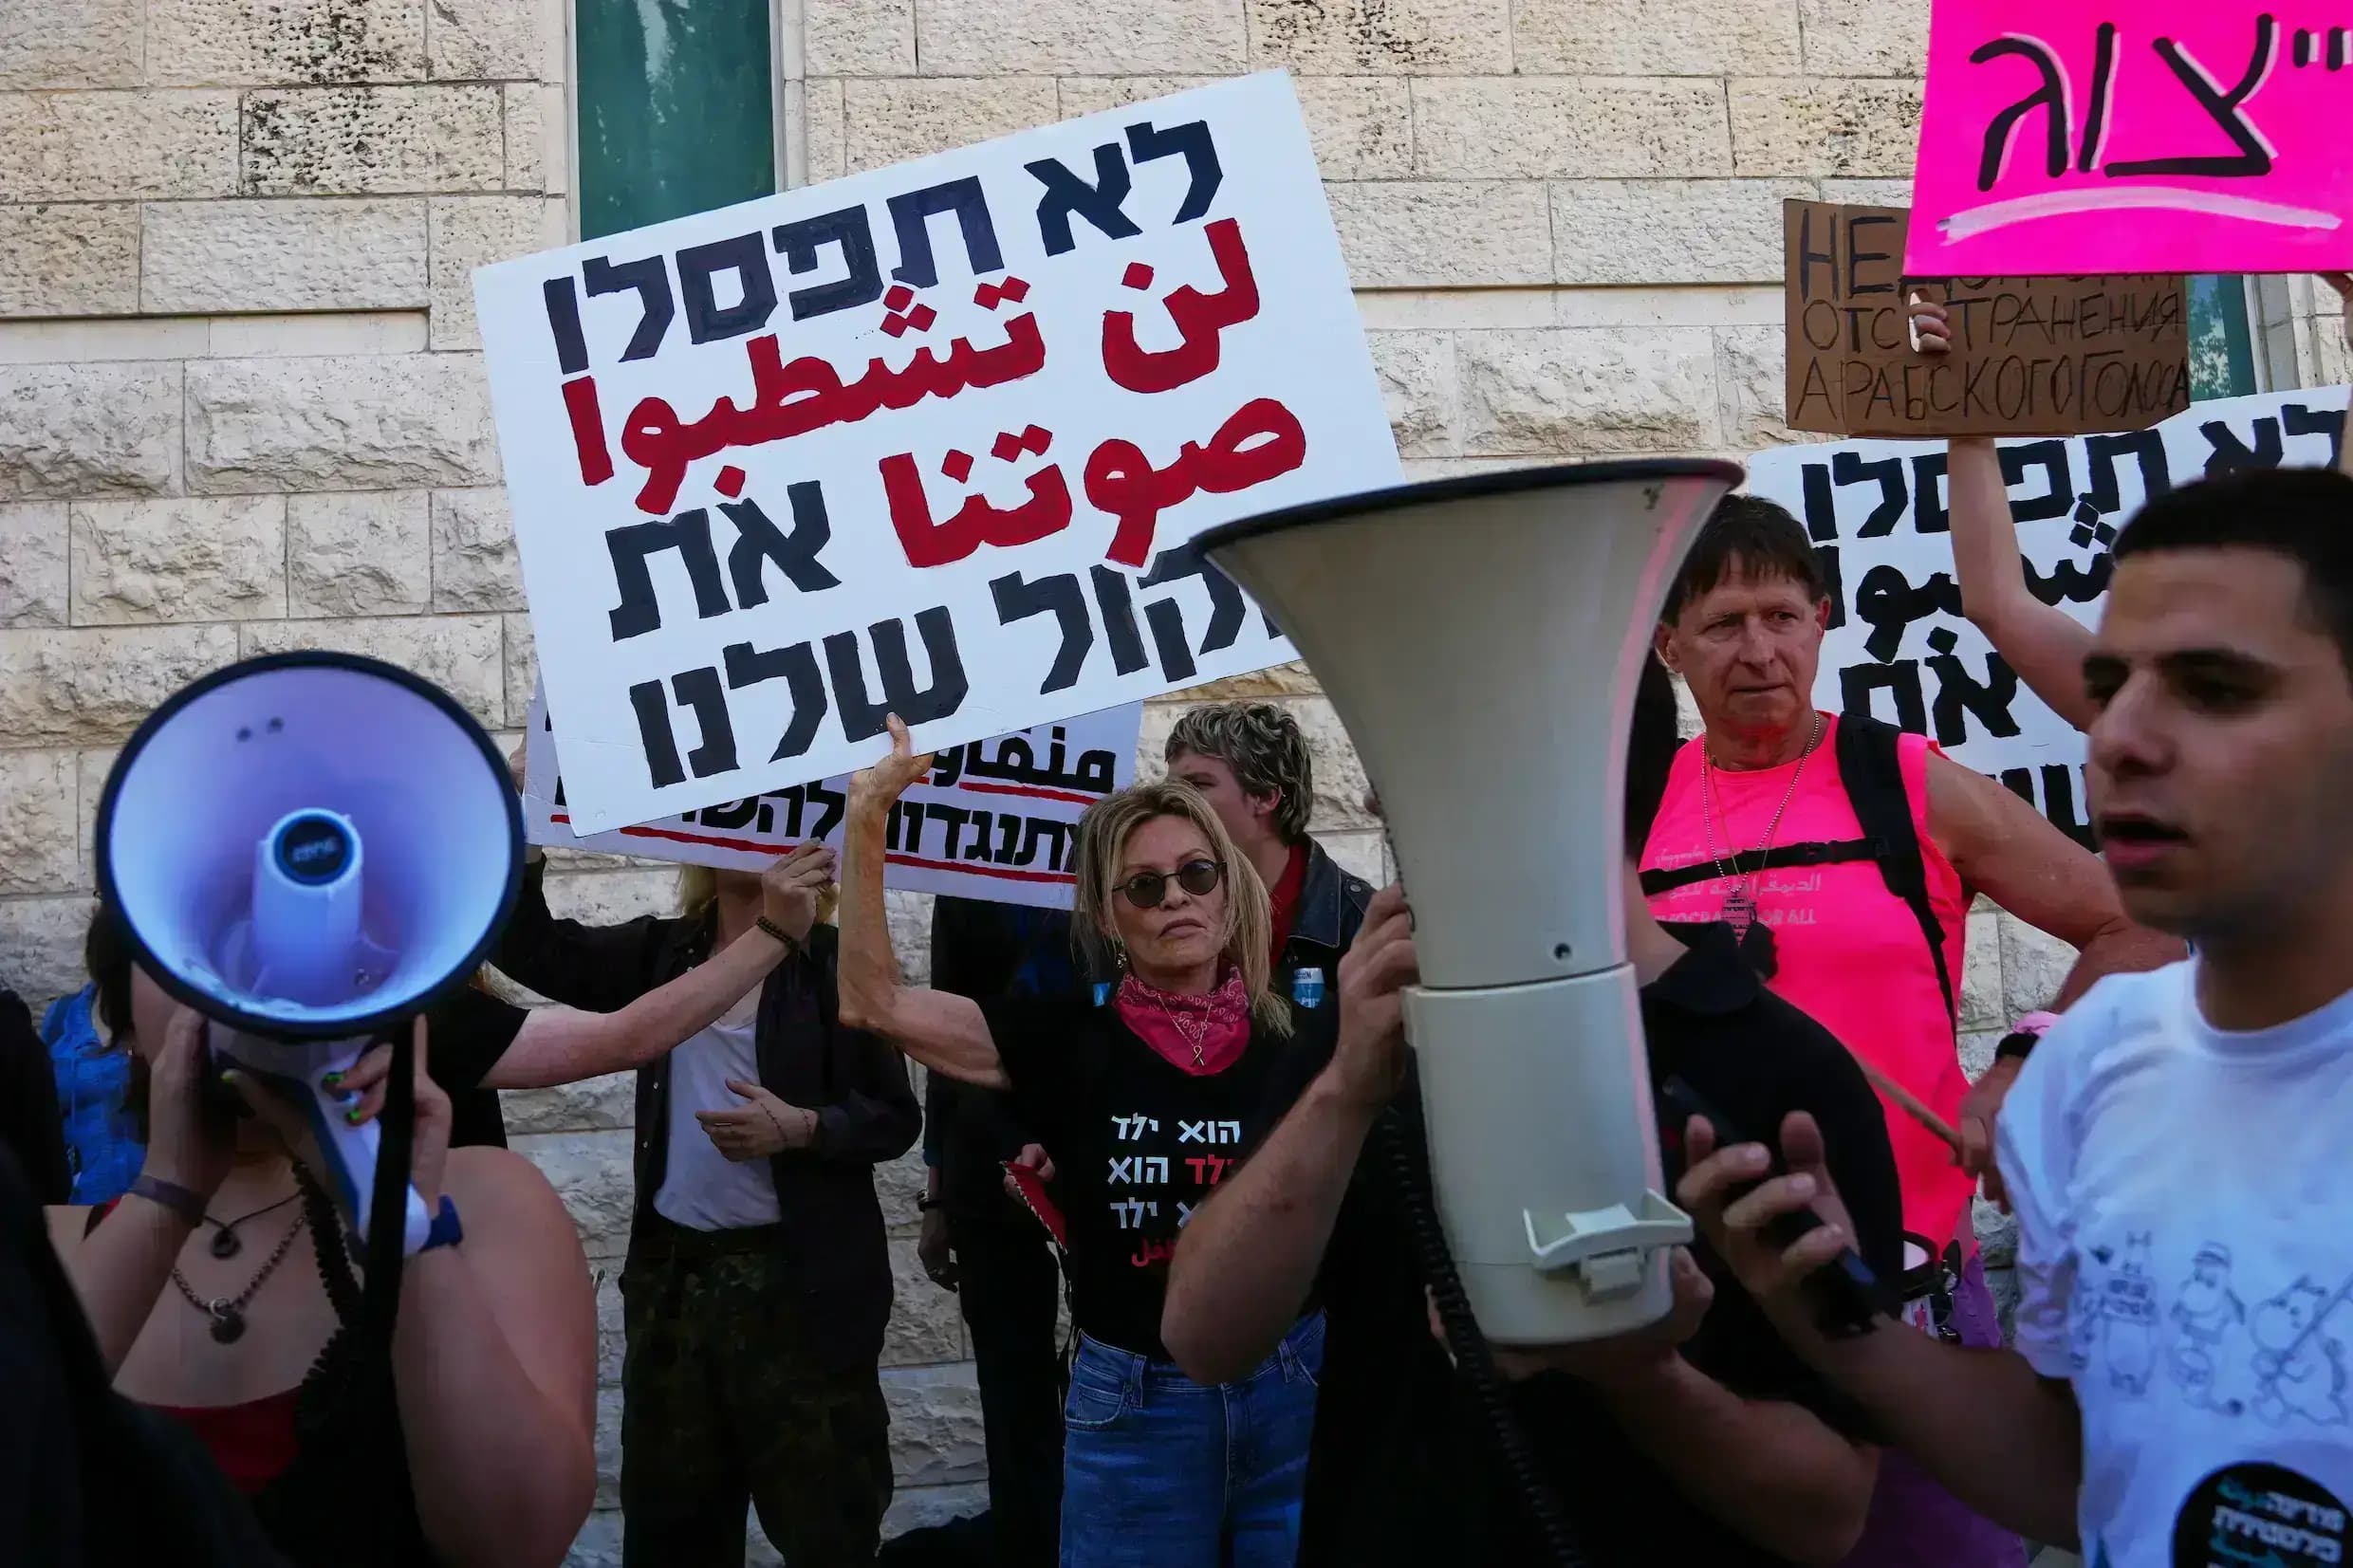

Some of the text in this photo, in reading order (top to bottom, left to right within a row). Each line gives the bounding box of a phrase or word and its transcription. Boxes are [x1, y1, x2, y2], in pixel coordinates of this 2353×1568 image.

[544, 120, 1224, 375] לא תפסלו
[1799, 209, 1898, 301] НЕ
[561, 217, 1259, 515] لن تشطبوا
[1794, 356, 2072, 423] АРАБСКОГО
[879, 397, 1306, 568] صوتنا
[603, 480, 843, 642] את
[629, 543, 1283, 789] קול שלנו
[1787, 908, 1817, 926] ALL
[1108, 1156, 1168, 1185] הוא
[1111, 1112, 1240, 1144] הוא ילד
[1110, 1197, 1158, 1229] ילד
